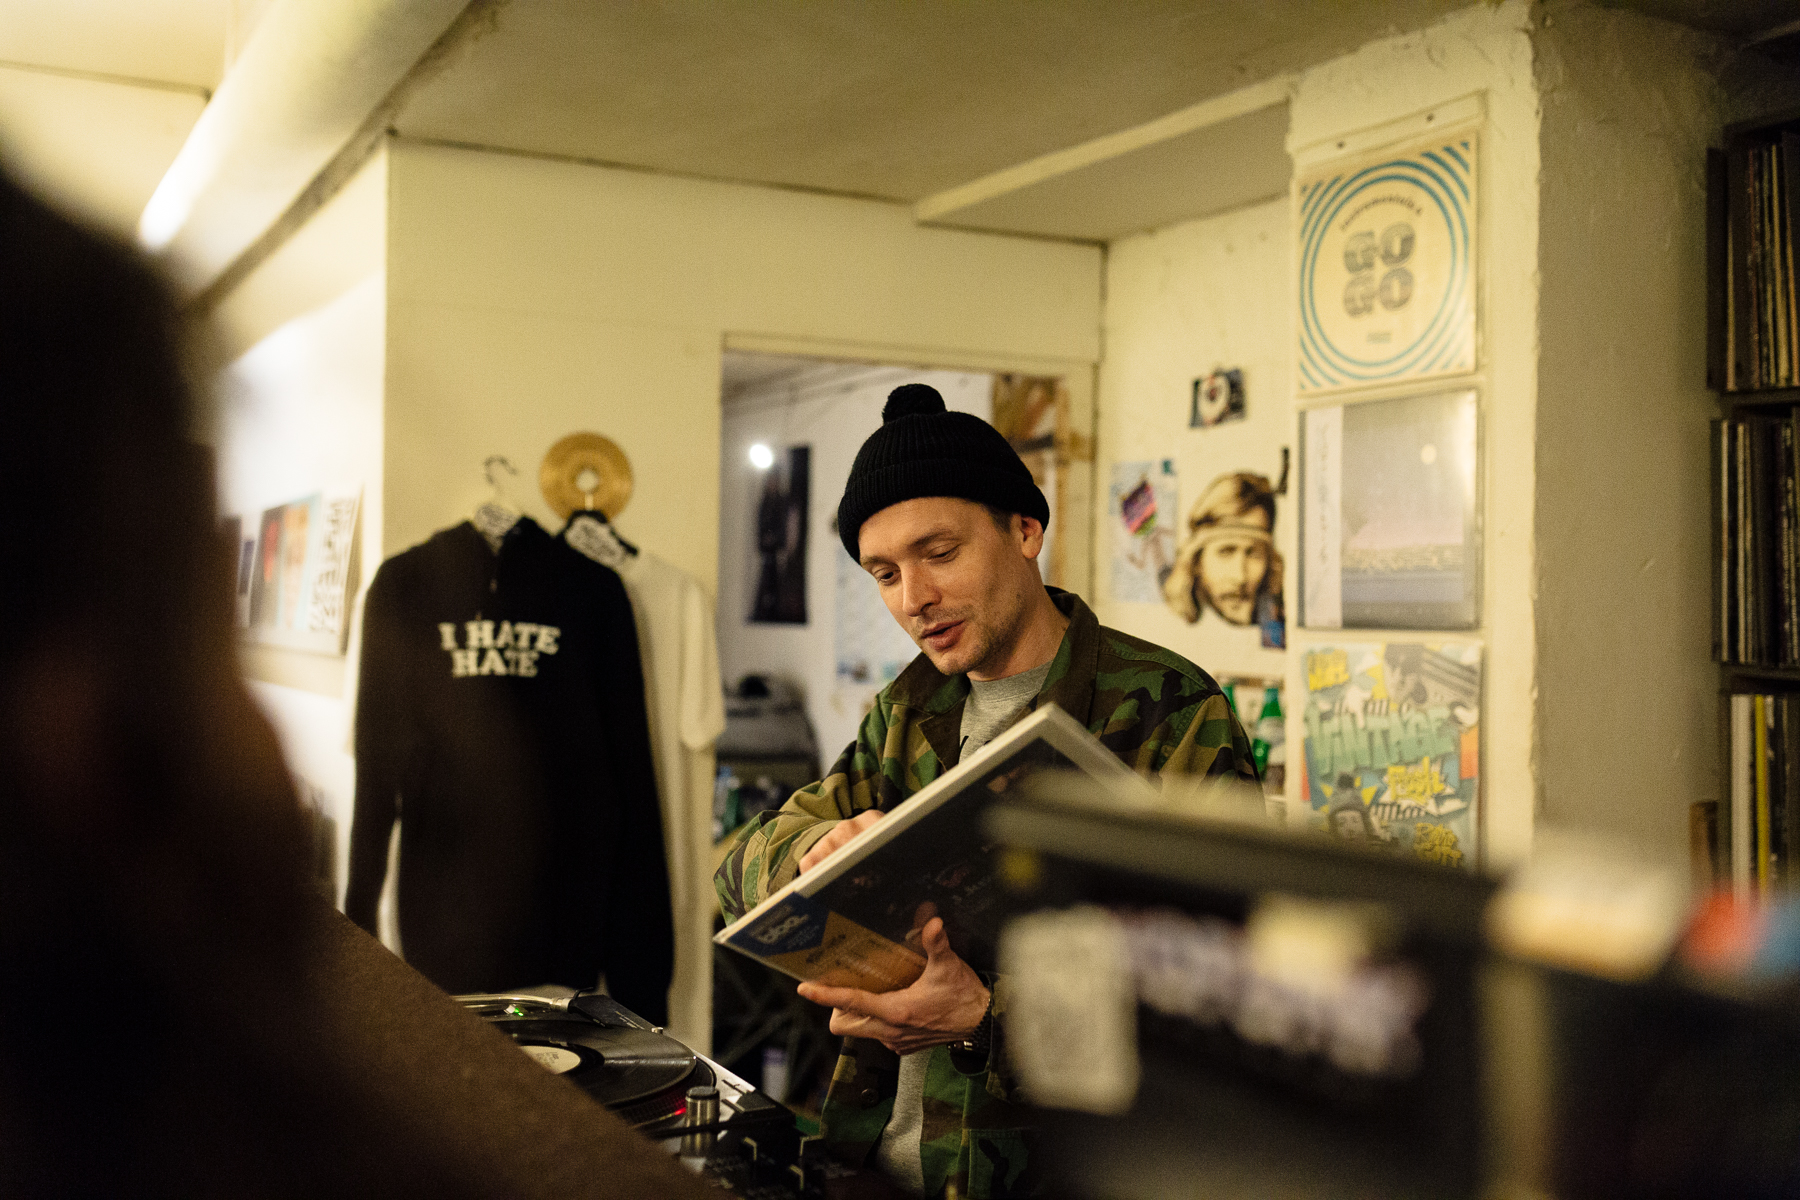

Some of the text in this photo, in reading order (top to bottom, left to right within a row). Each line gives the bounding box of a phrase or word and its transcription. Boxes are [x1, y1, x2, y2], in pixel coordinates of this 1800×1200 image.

[438, 620, 561, 655] I HATE
[450, 649, 539, 678] HATE
